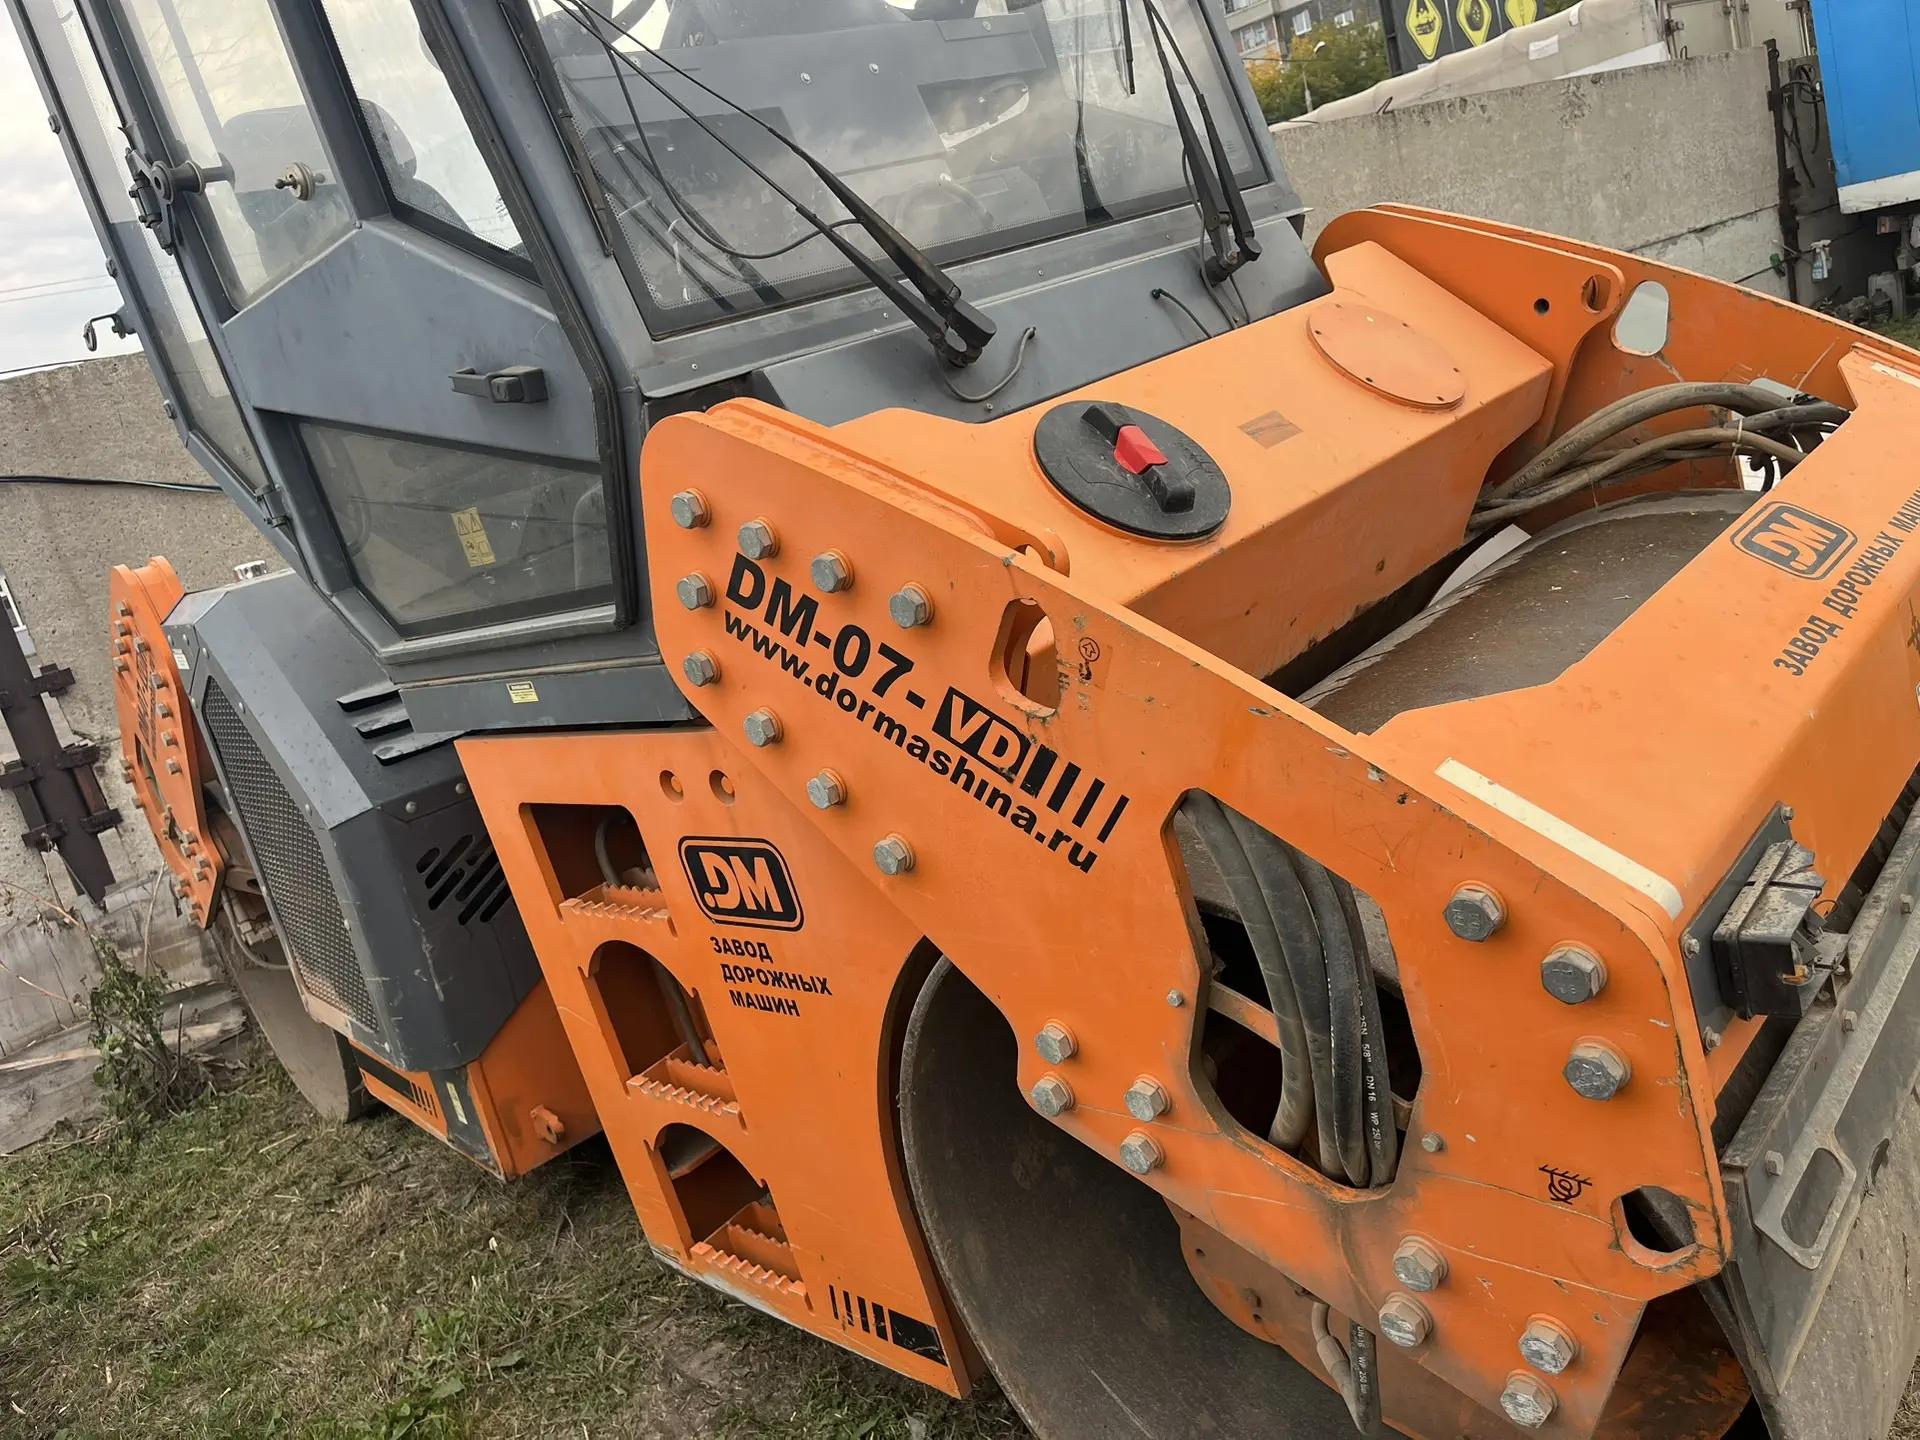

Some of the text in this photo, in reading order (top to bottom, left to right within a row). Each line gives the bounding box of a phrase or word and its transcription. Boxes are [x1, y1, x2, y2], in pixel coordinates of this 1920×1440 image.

[1751, 512, 1838, 571] DM
[1773, 486, 1920, 676] ЗАВОД ДОРОЖНЫХ МАШ
[723, 608, 1099, 874] www.dormashina.ru
[698, 851, 784, 913] DM
[709, 936, 774, 963] ЗАВОД
[720, 963, 832, 996] ДОРОЖНЫХ
[729, 989, 801, 1017] МАШИН
